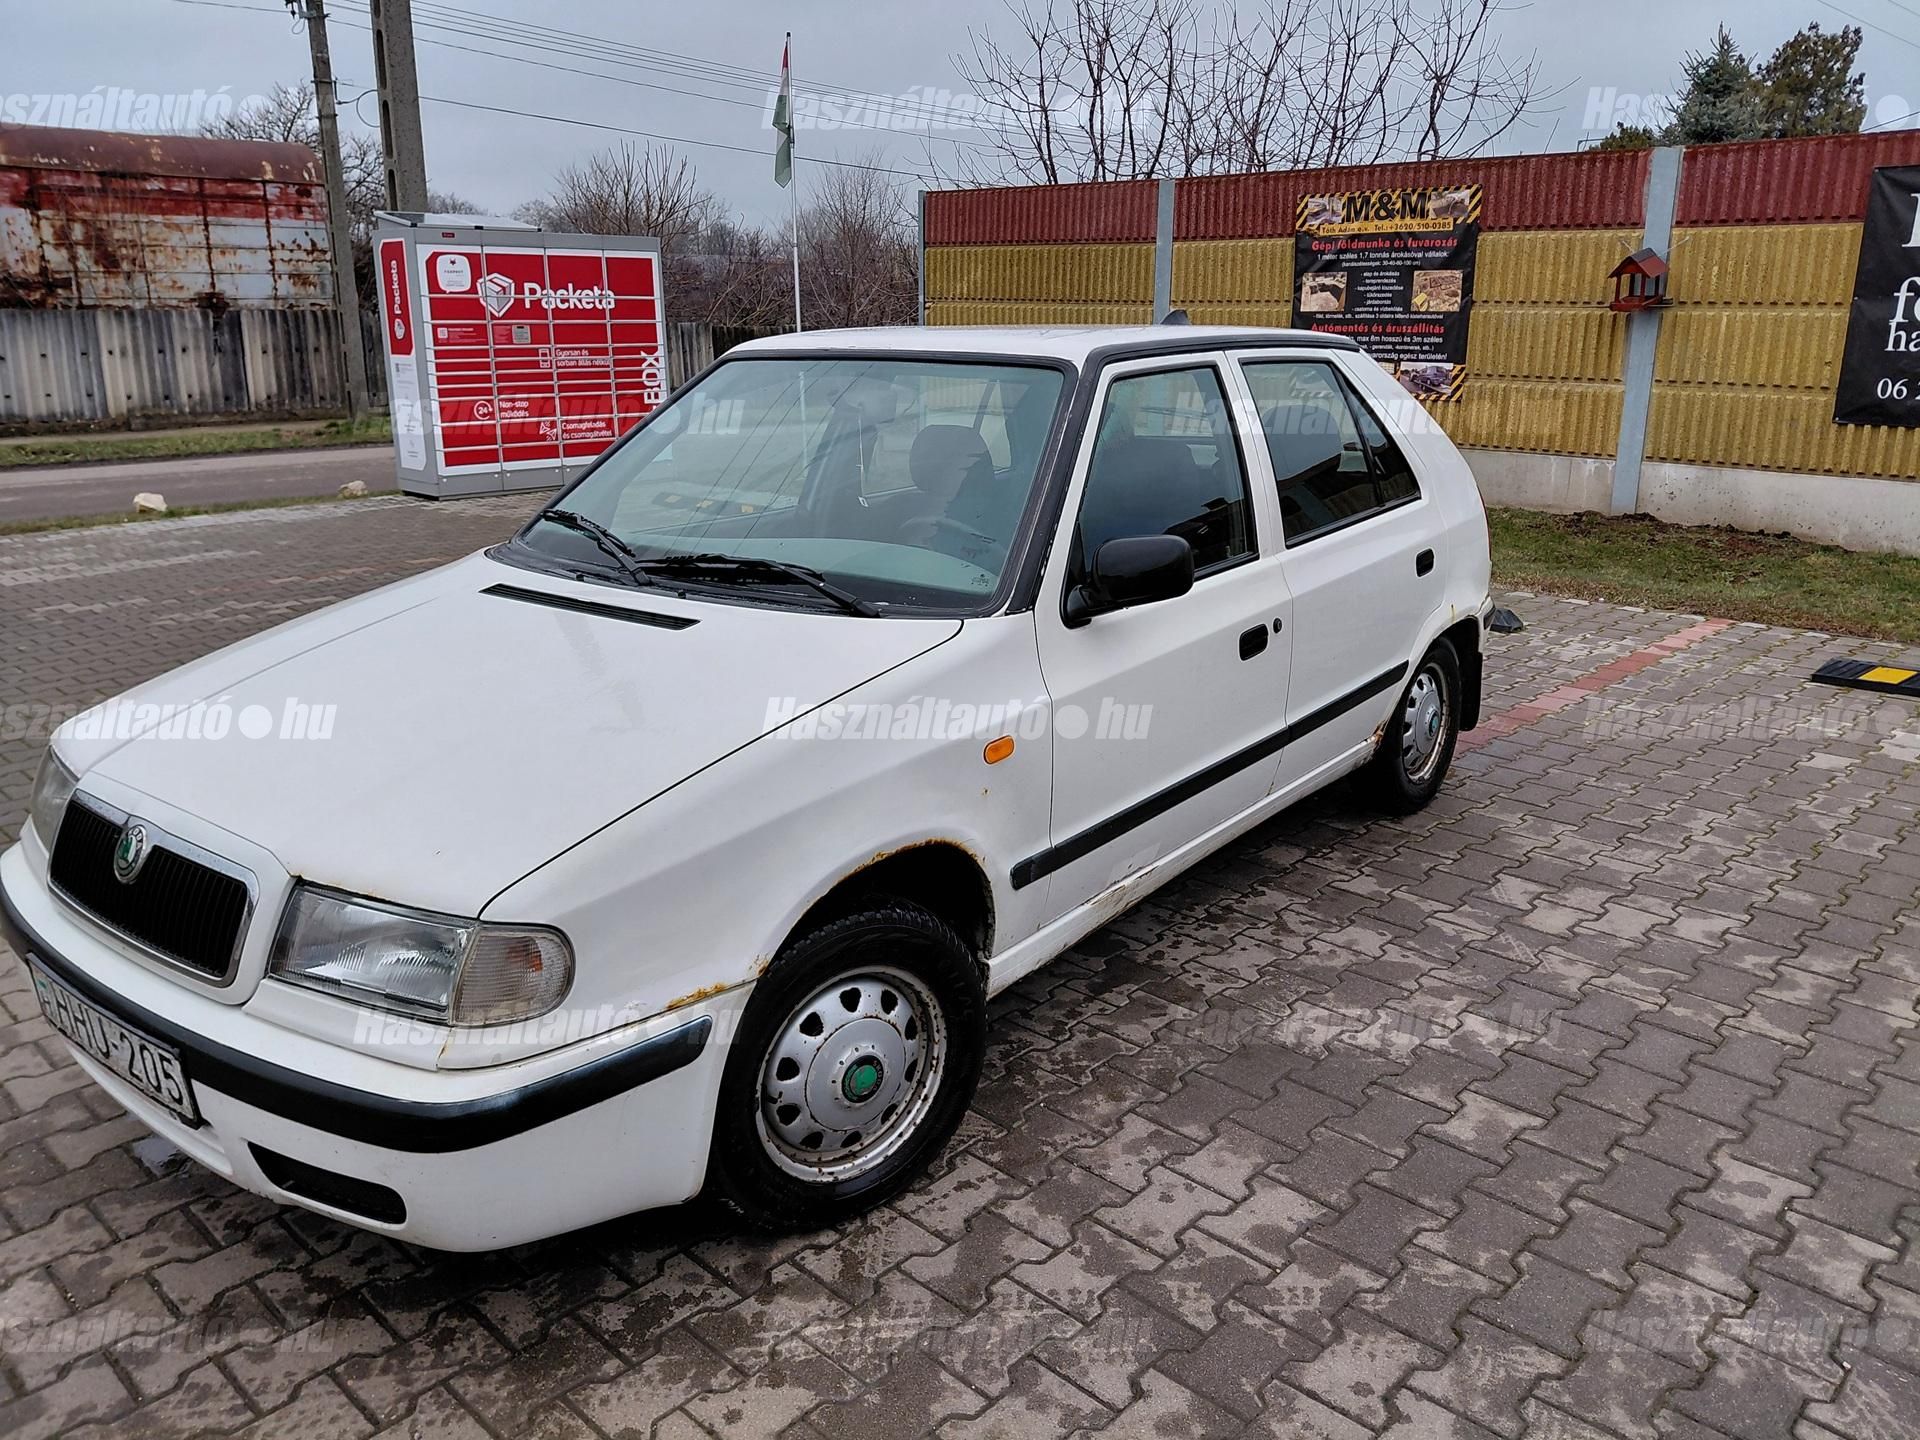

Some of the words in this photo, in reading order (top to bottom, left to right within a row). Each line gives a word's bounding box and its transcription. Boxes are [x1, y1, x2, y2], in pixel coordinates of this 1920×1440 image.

[1345, 192, 1428, 222] M&M
[1337, 237, 1391, 250] földmunka
[1393, 238, 1404, 248] és
[1407, 236, 1458, 248] fuvarozás
[390, 259, 402, 315] Packeta
[523, 282, 616, 310] Packeta
[1311, 322, 1369, 332] Autómentés
[1371, 323, 1383, 332] és
[1386, 322, 1445, 333] áruszállítás
[555, 348, 580, 358] Gyorsan
[581, 348, 589, 356] és
[556, 359, 577, 367] sorban
[1877, 377, 1909, 400] 06
[478, 406, 488, 414] 24
[499, 400, 529, 409] Non-stop
[50, 981, 184, 1106] HHU-205
